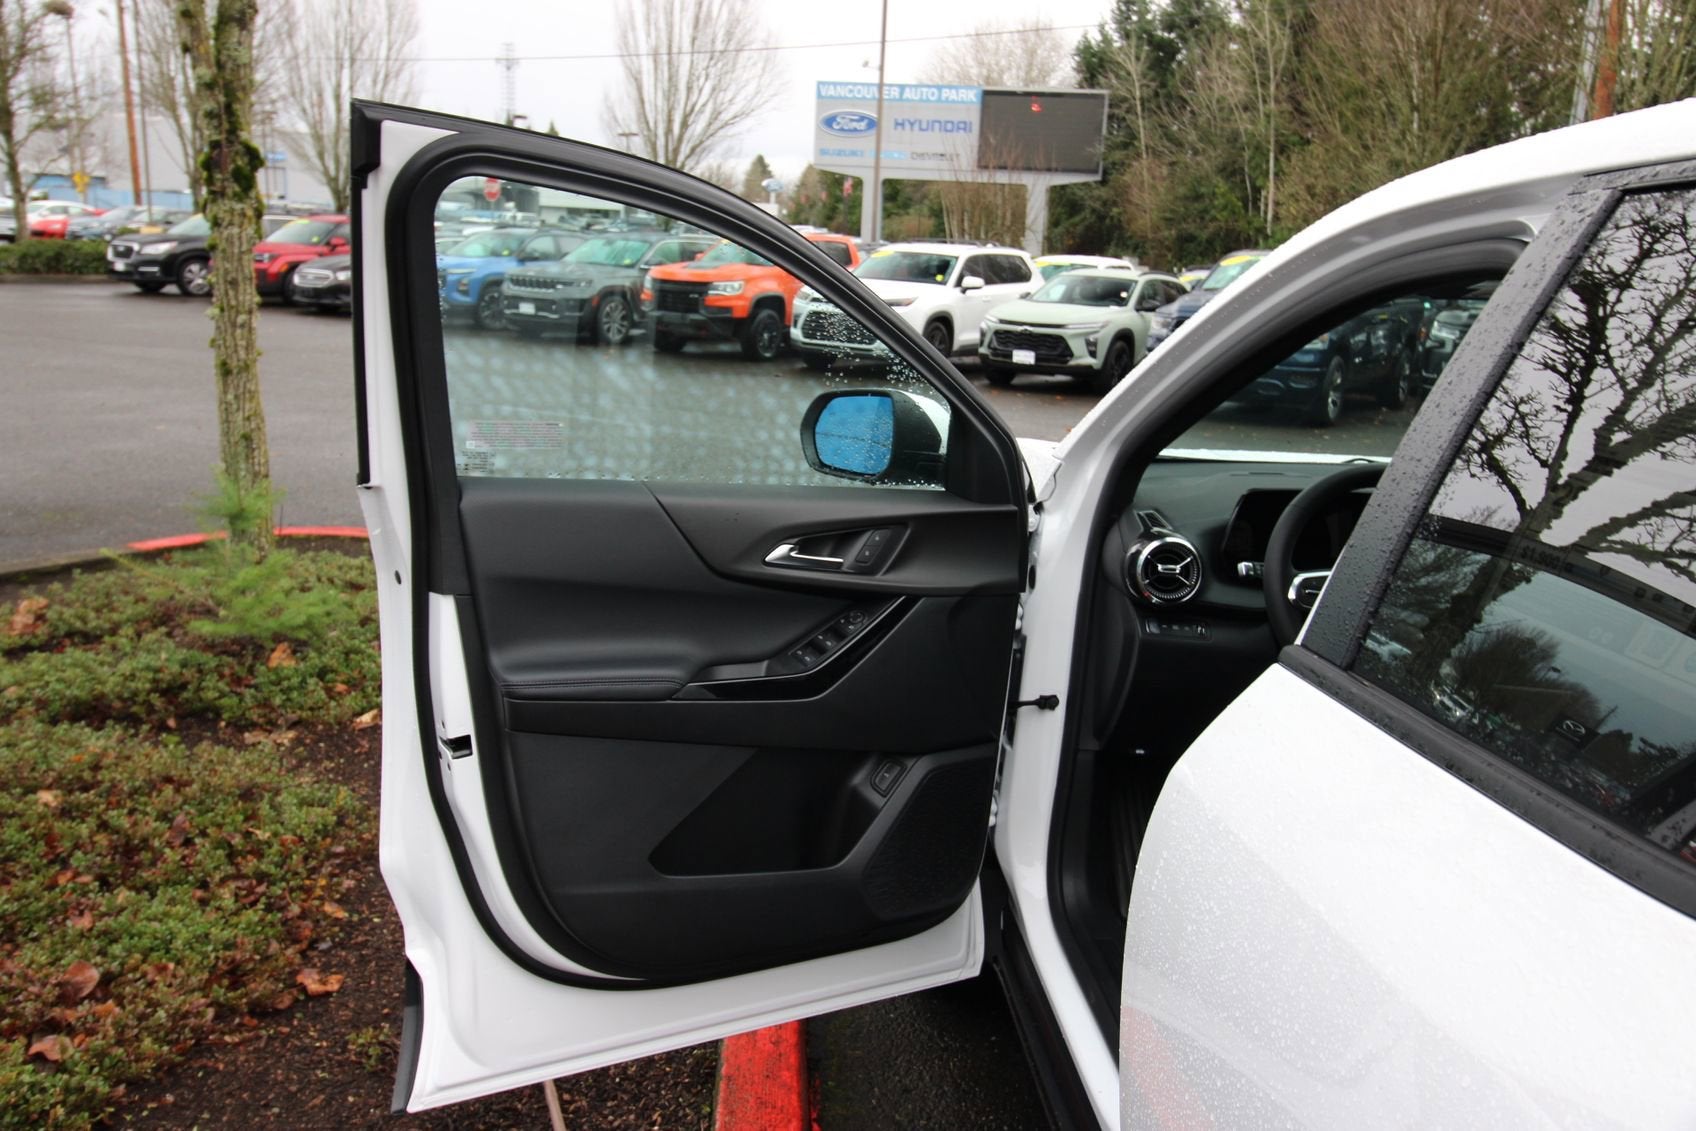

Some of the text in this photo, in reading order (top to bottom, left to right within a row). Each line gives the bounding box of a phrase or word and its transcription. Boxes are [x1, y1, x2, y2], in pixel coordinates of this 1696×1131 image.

[902, 87, 938, 101] AUTO
[941, 88, 977, 102] PARK
[831, 114, 869, 131] Ford
[893, 118, 973, 133] HYUNDAI
